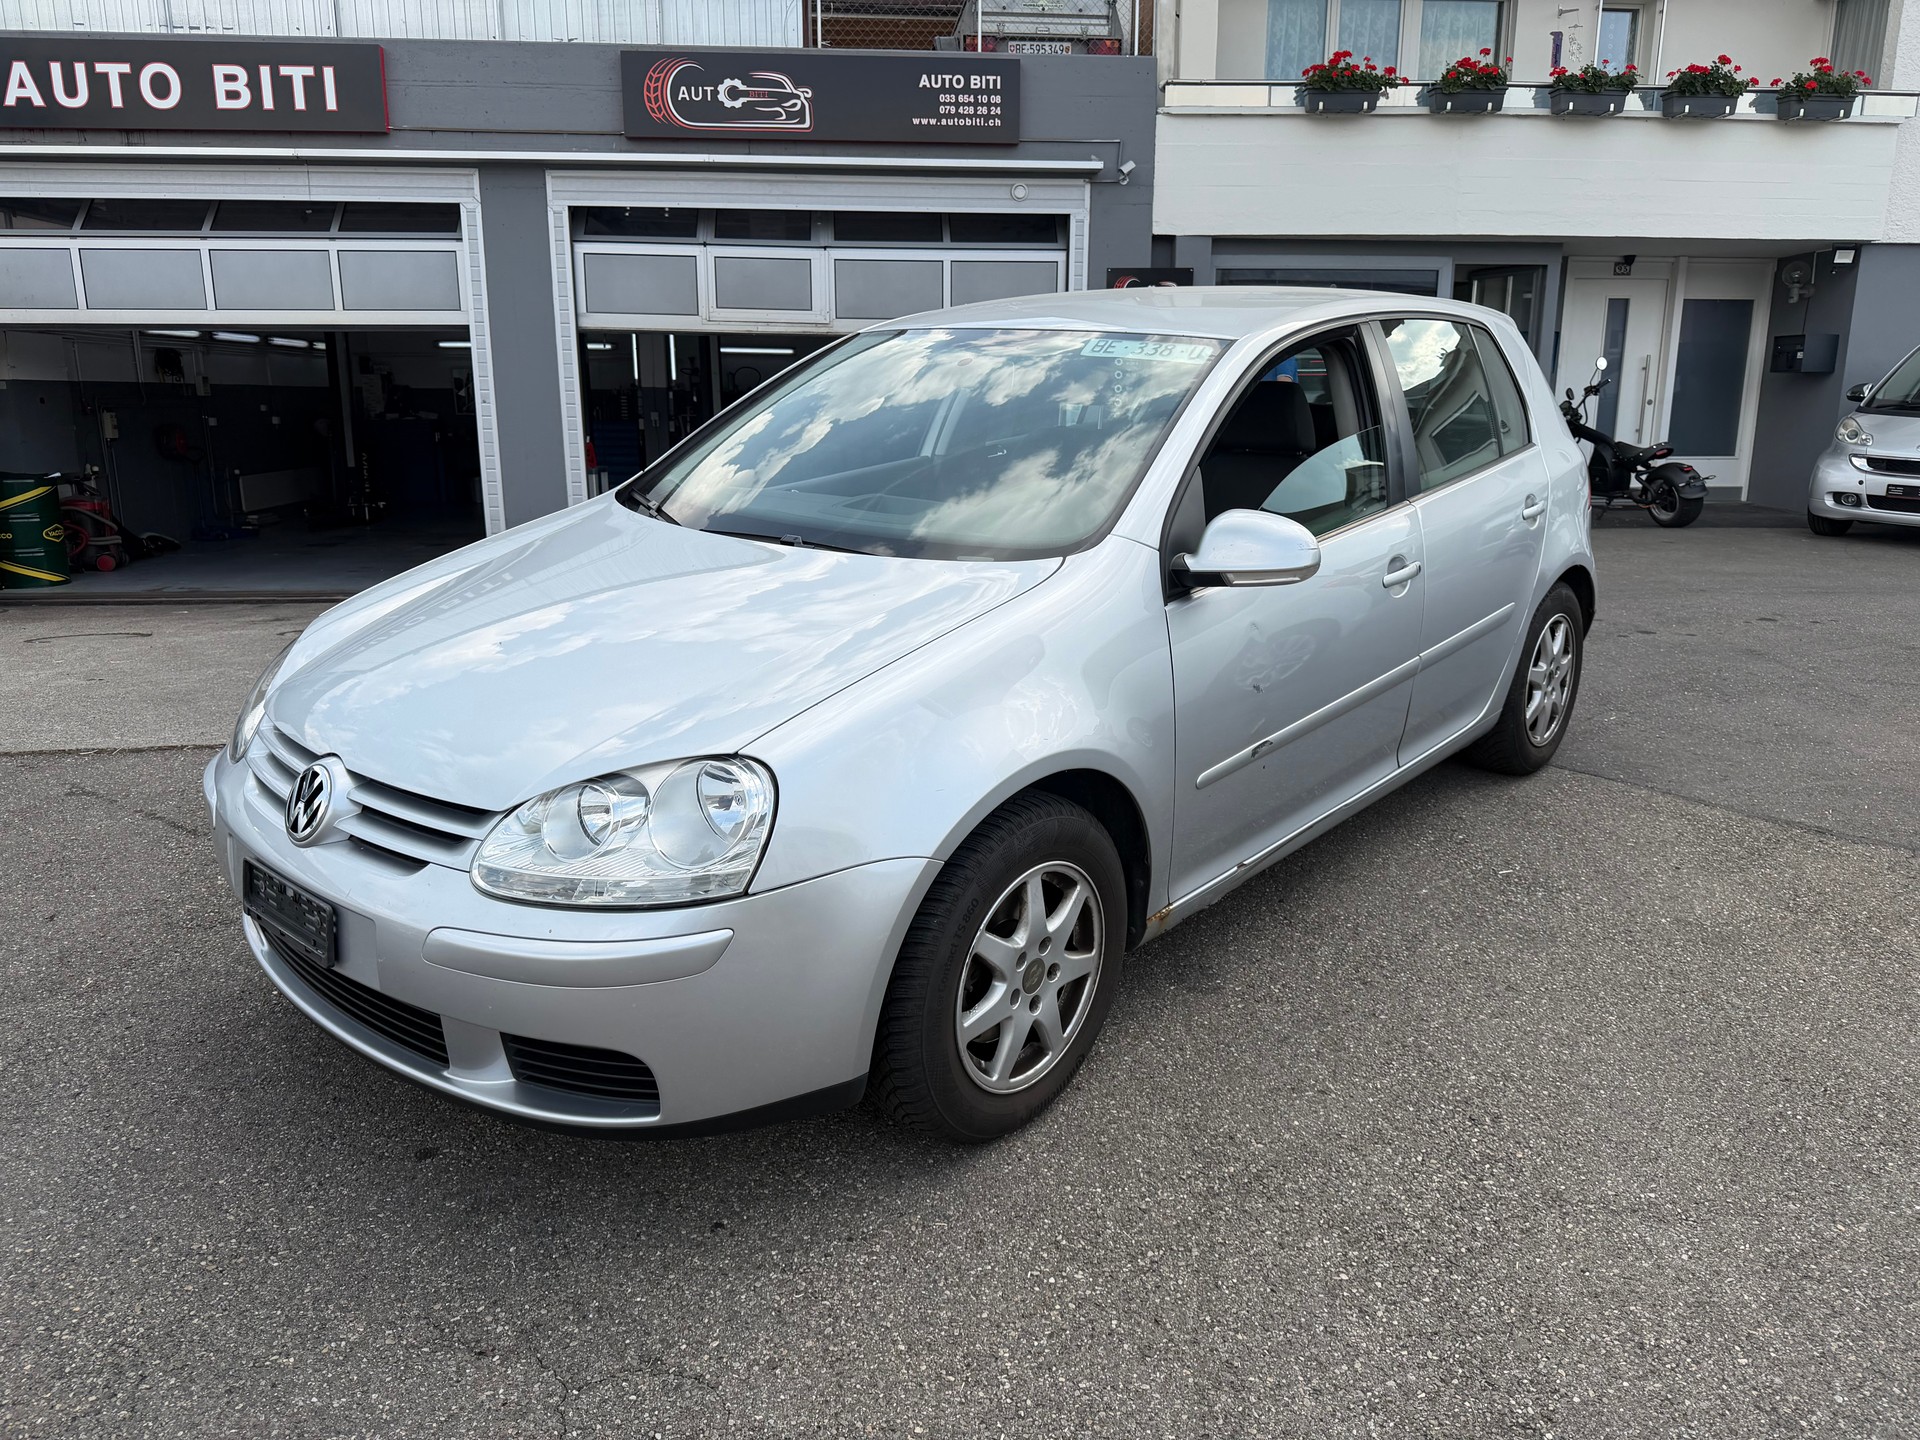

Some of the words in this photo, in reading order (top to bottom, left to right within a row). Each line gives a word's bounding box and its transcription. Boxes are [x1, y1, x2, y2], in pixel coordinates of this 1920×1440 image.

[3, 60, 182, 110] AUTO
[212, 63, 338, 111] BITI
[918, 74, 965, 89] AUTO
[970, 75, 1001, 89] BITI
[749, 90, 769, 98] BITI
[939, 94, 956, 103] 033
[958, 94, 974, 103] 654
[977, 95, 988, 103] 10
[990, 95, 1001, 104] 08
[939, 105, 956, 114] 079
[958, 106, 974, 115] 428
[977, 106, 988, 115] 26
[990, 106, 1001, 115] 24
[912, 117, 1001, 127] www.autobiti.ch
[962, 897, 979, 922] 860
